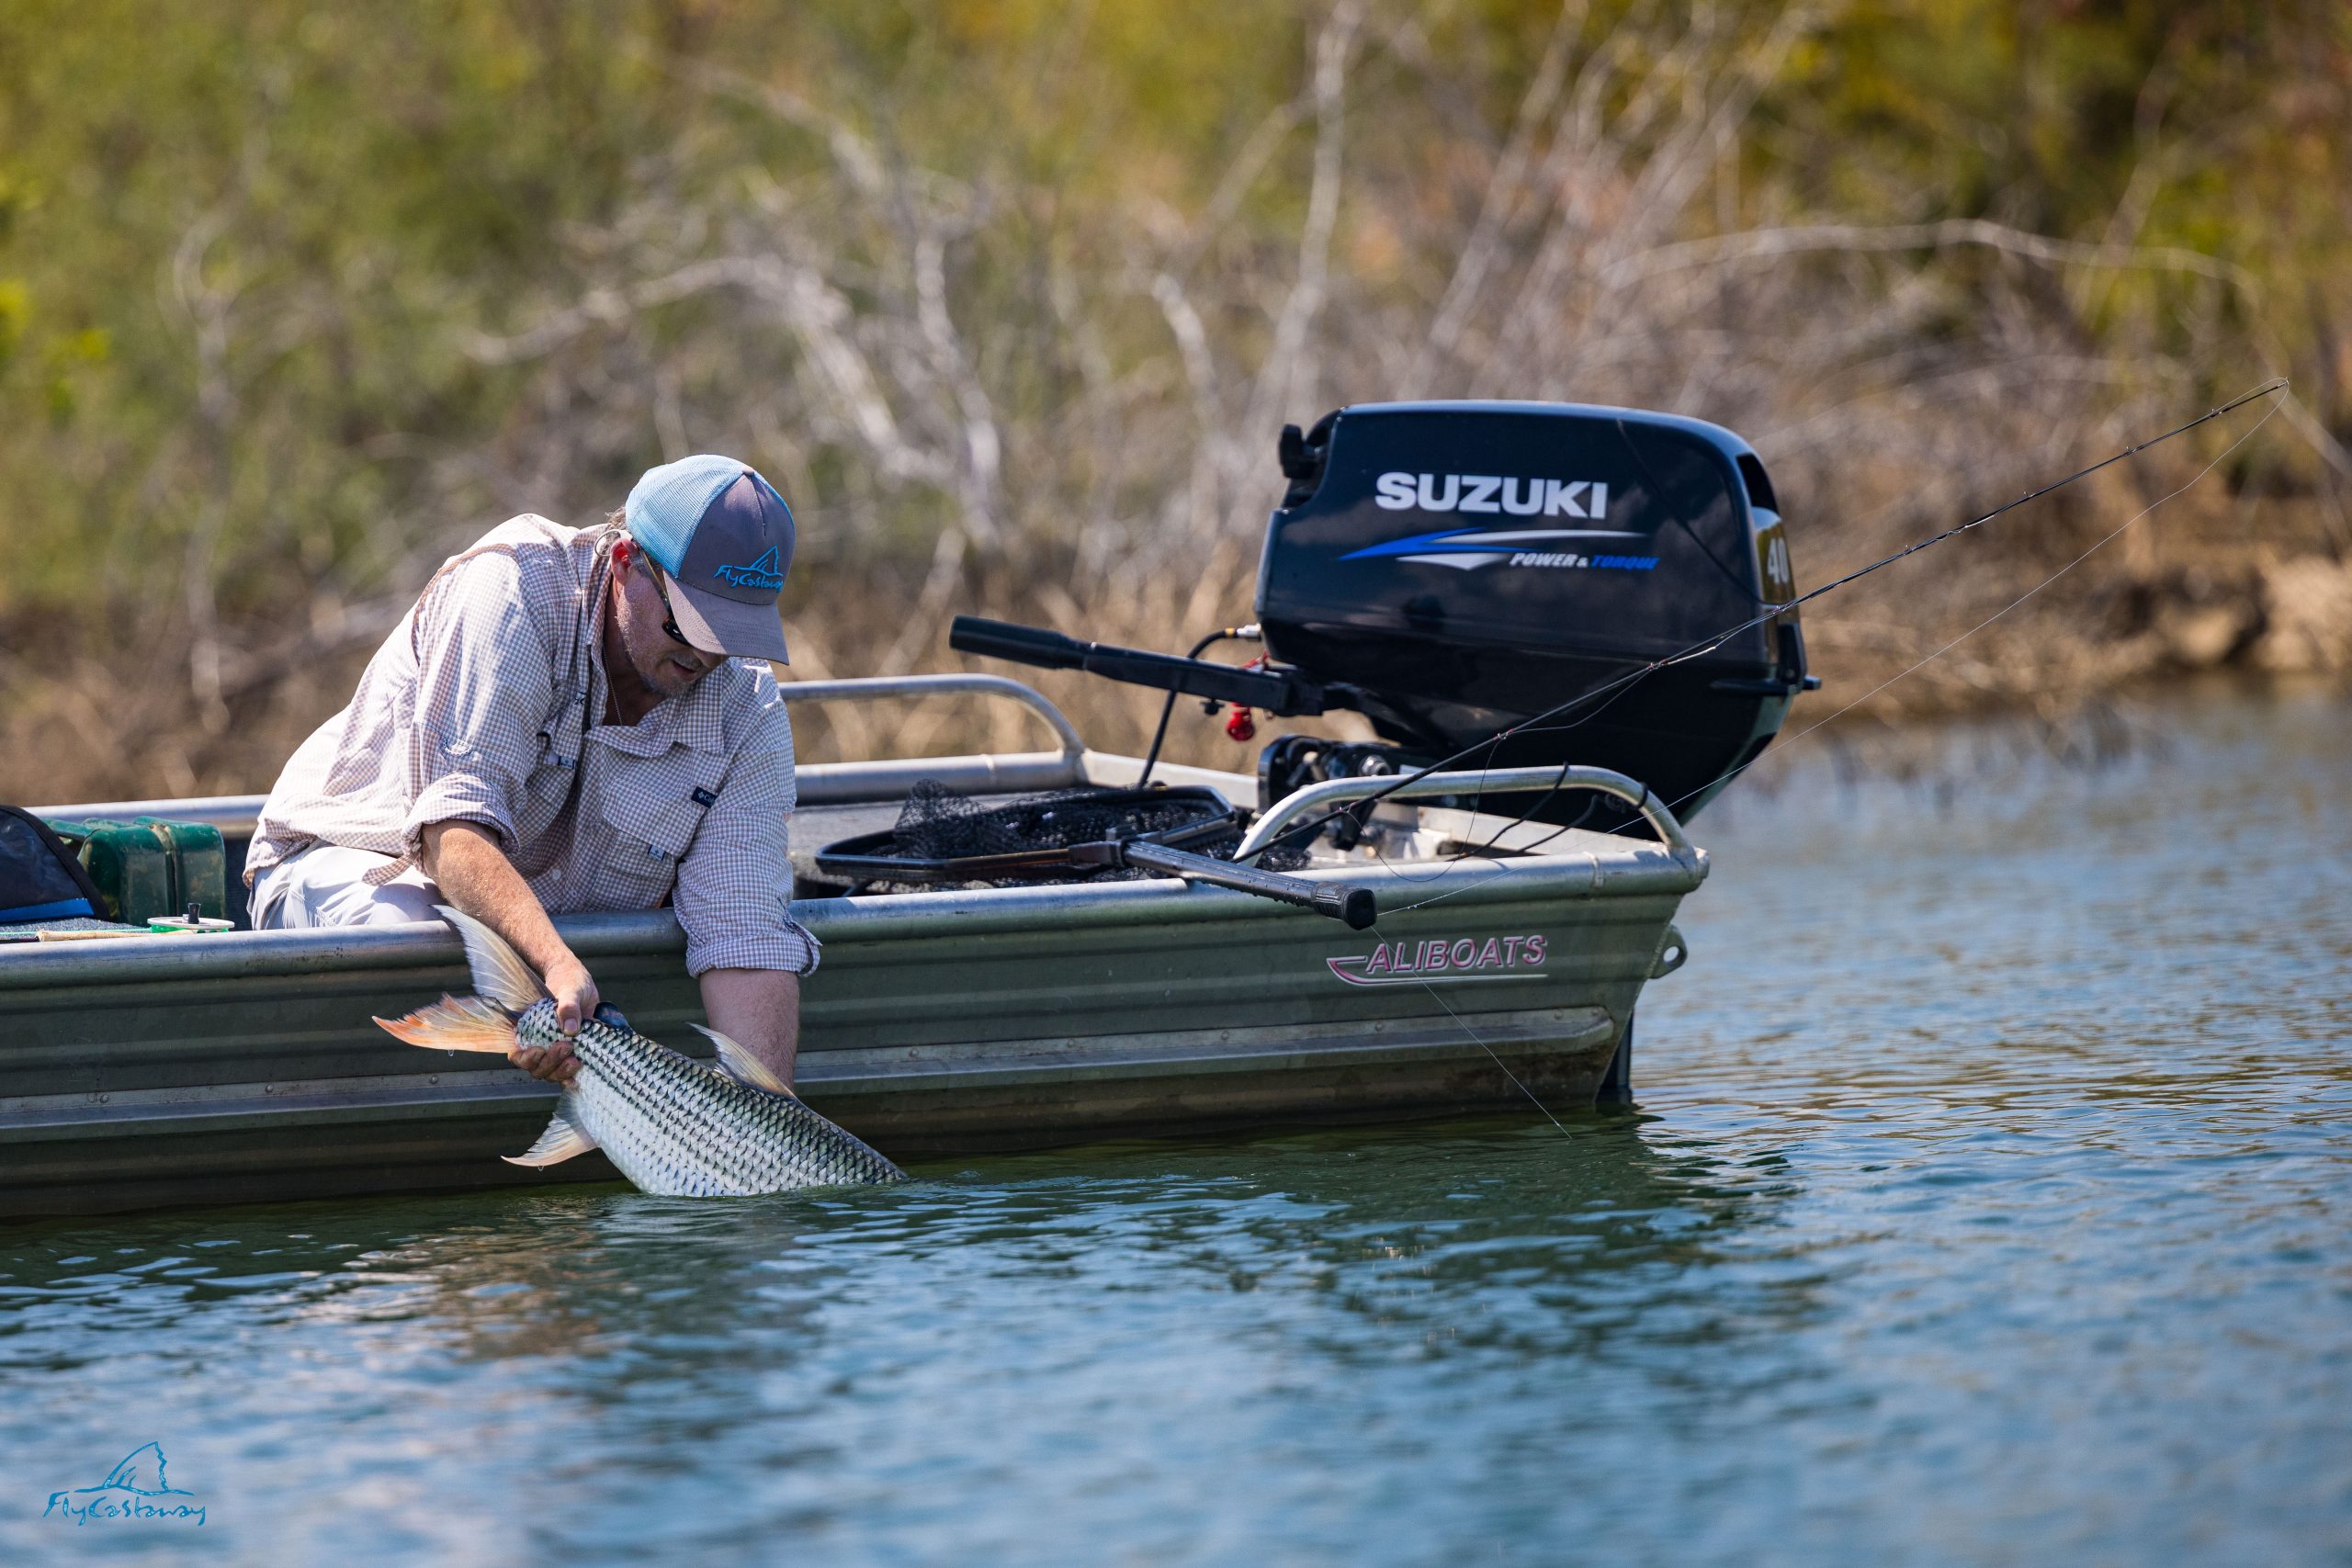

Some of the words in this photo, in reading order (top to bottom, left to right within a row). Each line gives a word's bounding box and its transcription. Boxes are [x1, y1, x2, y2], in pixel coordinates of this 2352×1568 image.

[1374, 471, 1608, 519] SUZUKI
[1510, 552, 1578, 568] POWER
[1577, 557, 1589, 568] &
[1590, 554, 1659, 570] TORQUE
[1767, 537, 1790, 583] 40
[1365, 934, 1547, 975] ALIBOATS
